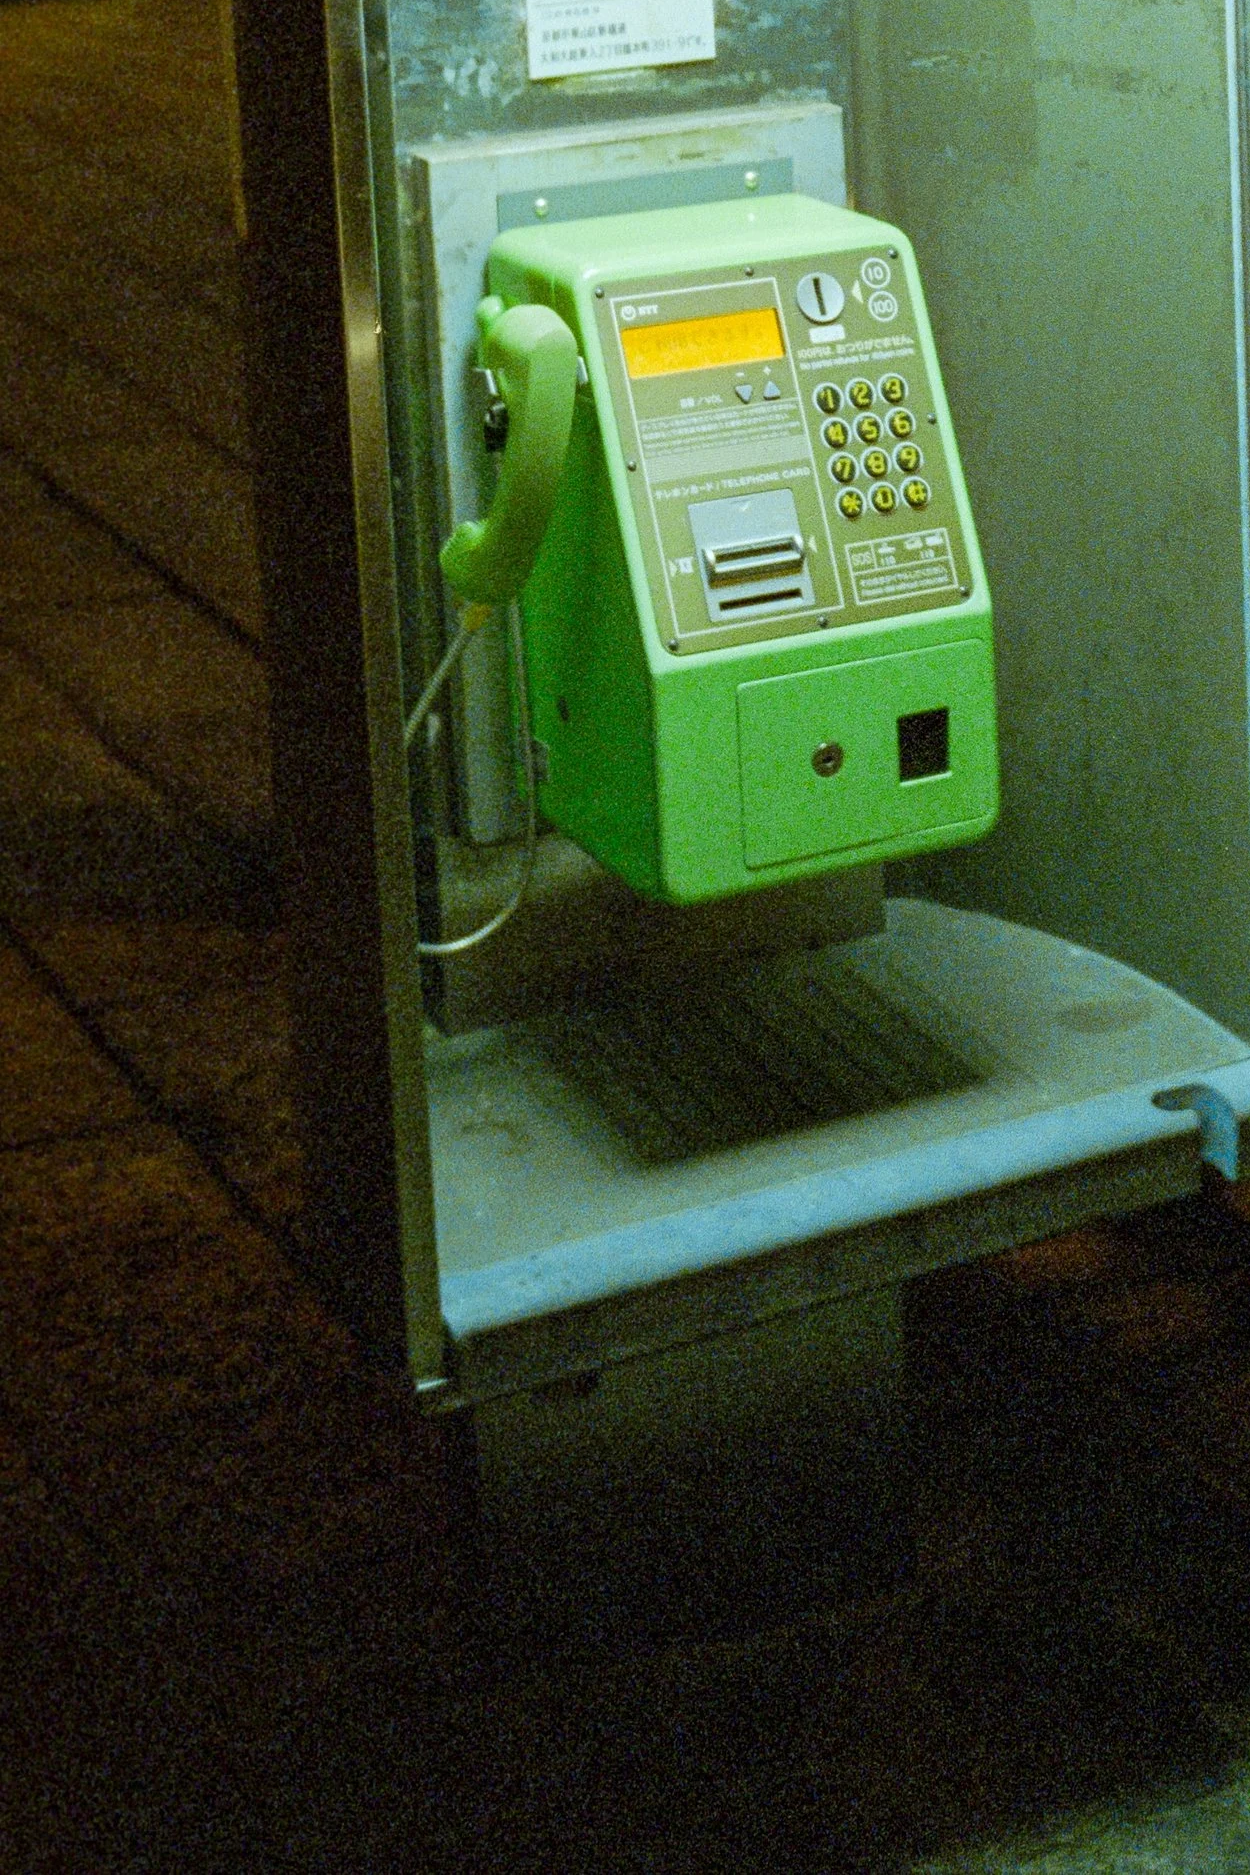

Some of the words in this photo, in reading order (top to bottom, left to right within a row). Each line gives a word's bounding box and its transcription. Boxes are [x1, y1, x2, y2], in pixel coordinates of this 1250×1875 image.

[868, 266, 883, 281] 10
[874, 299, 893, 314] 100
[820, 388, 835, 410] 1
[852, 382, 870, 405] 2
[885, 377, 902, 400] 3
[828, 422, 846, 444] 4
[861, 416, 879, 440] 5
[893, 411, 911, 435] 6
[835, 457, 852, 480] 7
[867, 451, 885, 474] 8
[900, 446, 917, 469] 9
[721, 471, 780, 488] TELEPHONE
[782, 466, 811, 479] CARD
[875, 486, 893, 510] 0
